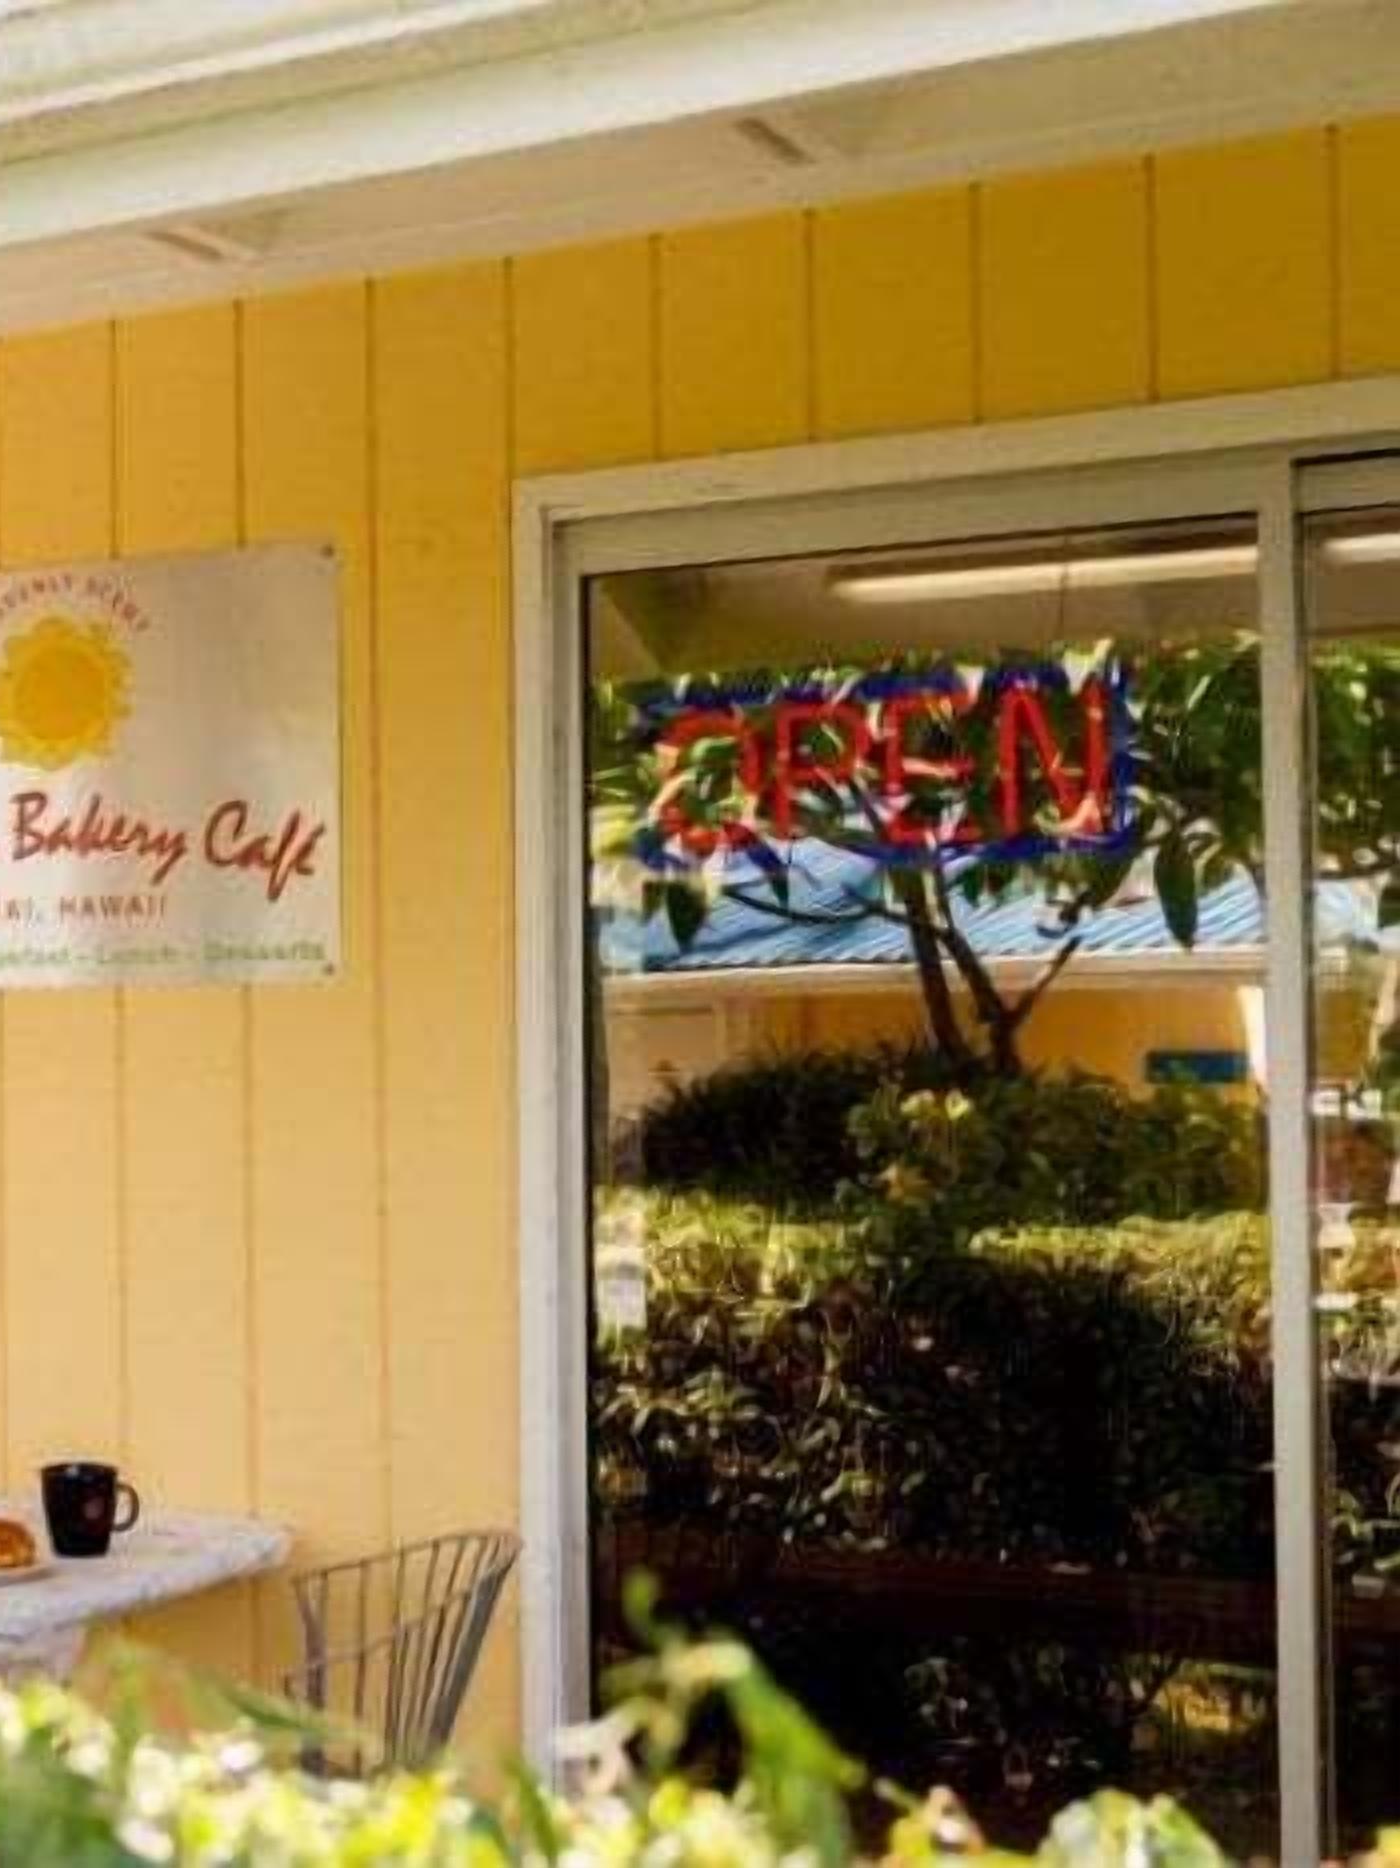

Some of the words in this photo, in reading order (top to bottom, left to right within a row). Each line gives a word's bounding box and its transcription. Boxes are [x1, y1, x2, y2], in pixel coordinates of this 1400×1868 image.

[656, 678, 1110, 854] OPEN
[9, 790, 191, 885] Bakery
[60, 896, 166, 918] HAWAII
